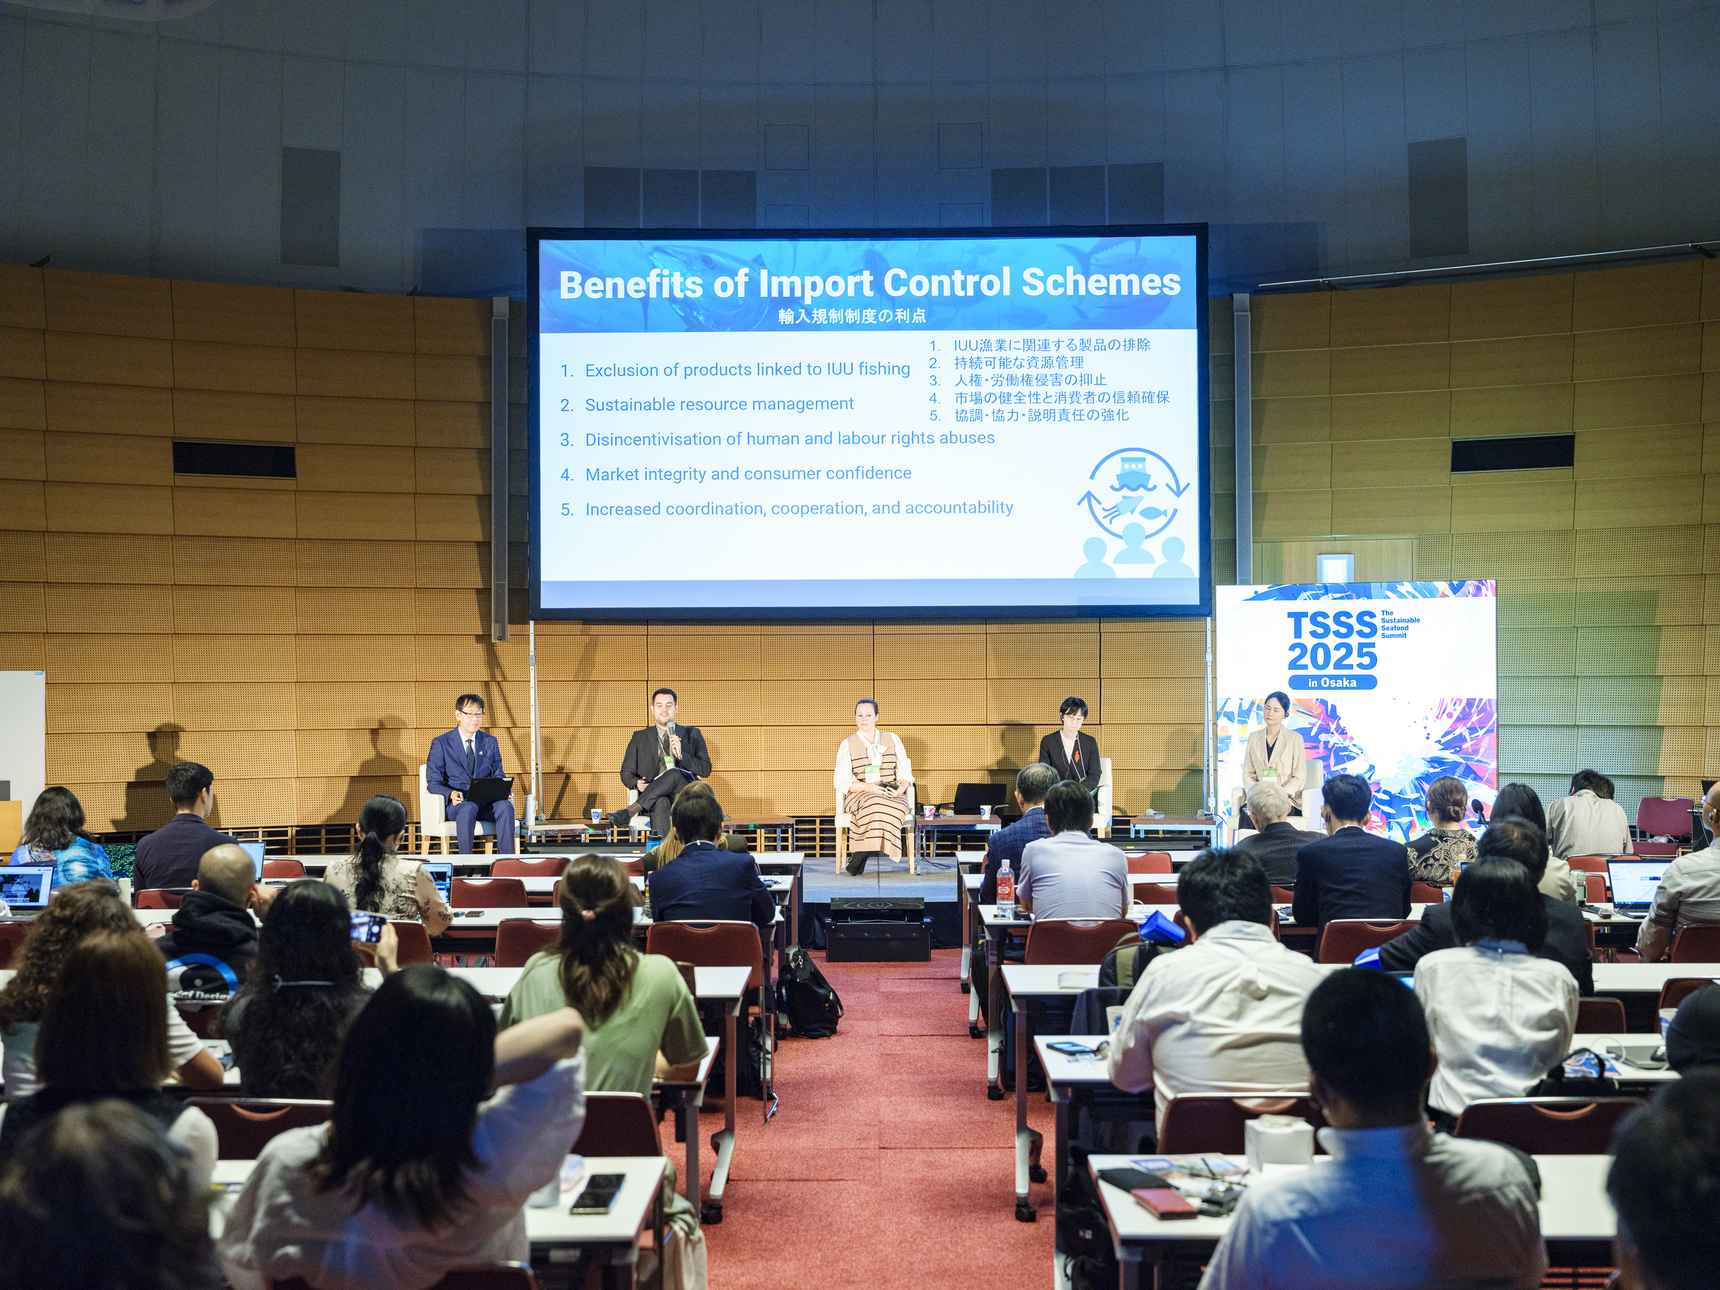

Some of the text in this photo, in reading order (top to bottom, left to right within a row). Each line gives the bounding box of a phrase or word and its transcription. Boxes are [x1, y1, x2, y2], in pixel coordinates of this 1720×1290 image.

[560, 266, 1181, 305] Benefits of Import Control Schemes
[778, 308, 927, 325] 輸入規制制度の利点
[929, 338, 1151, 353] 1. IUU漁業に関連する製品の排除
[560, 361, 911, 380] 1. Exclusion of products linked to IUU fishing
[929, 355, 1085, 370] 2. 持続可能な資源管理
[929, 374, 941, 387] 3.
[560, 397, 855, 415] 2. Sustainable resource management
[929, 390, 1171, 406] 4. 市場の健全性と消費者の信頼確保
[929, 409, 941, 422] 5.
[560, 430, 996, 449] 3. Disincentivisation of human and labour rights abuses
[560, 465, 913, 485] 4. Market integrity and consumer confidence
[560, 499, 1014, 519] 5. Increased coordination, cooperation, and accountability
[1381, 609, 1394, 617] The
[1287, 610, 1378, 639] TSSS
[1288, 642, 1378, 671] 2025
[1308, 677, 1357, 688] in Osaka
